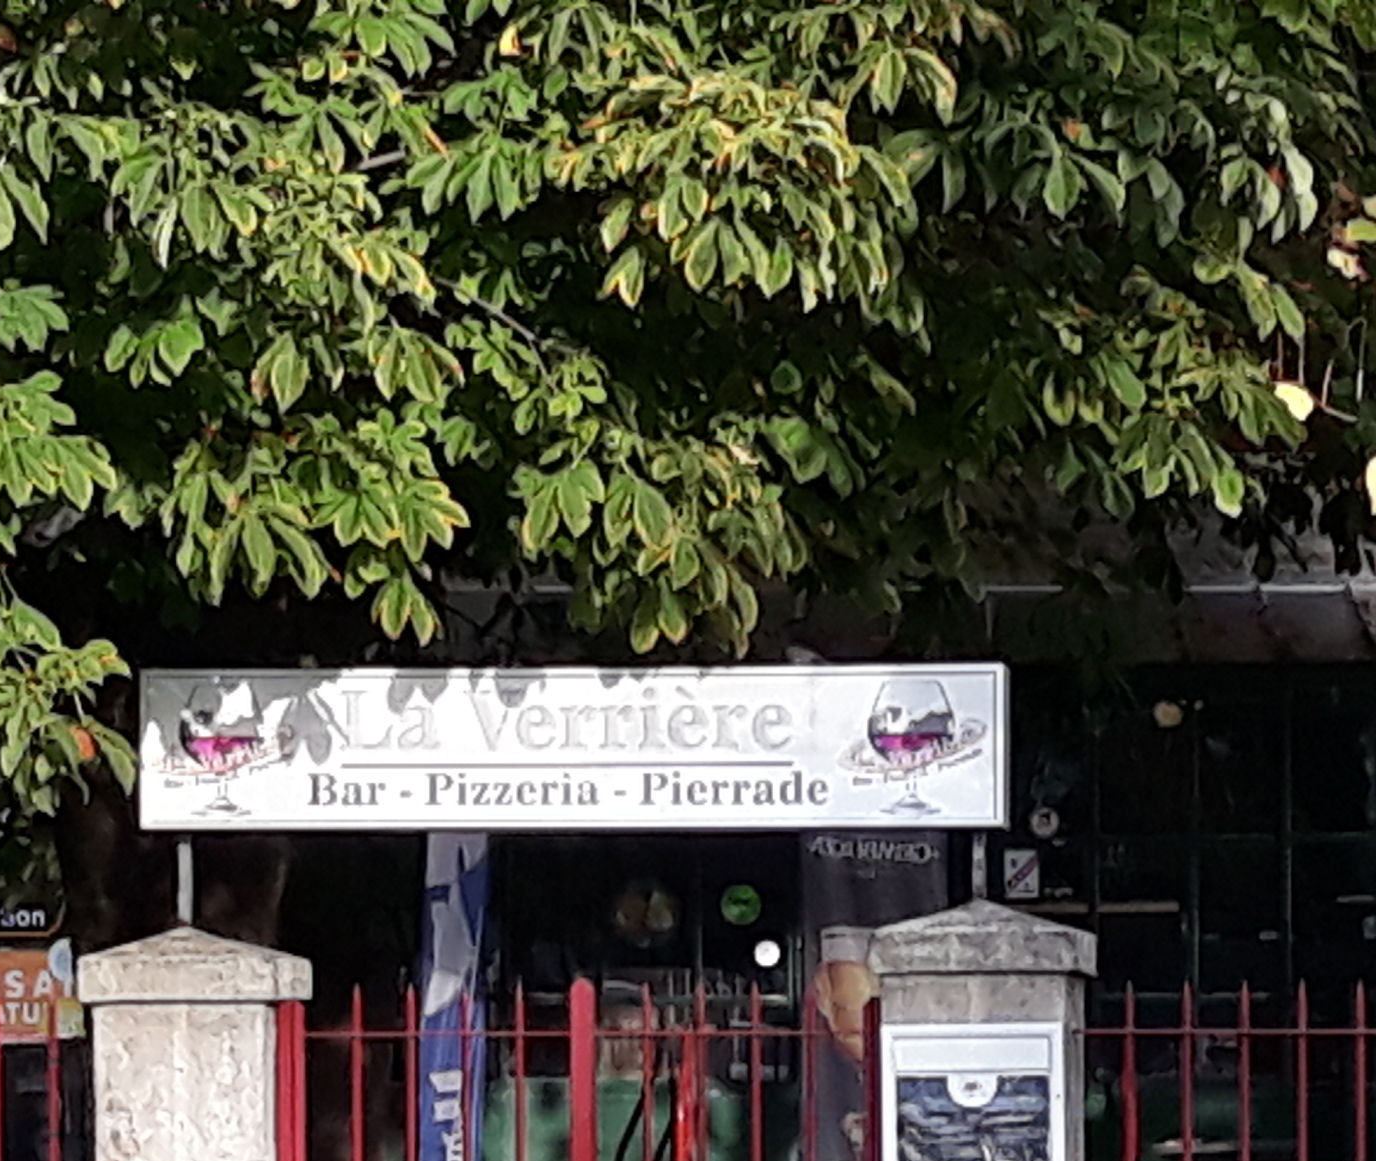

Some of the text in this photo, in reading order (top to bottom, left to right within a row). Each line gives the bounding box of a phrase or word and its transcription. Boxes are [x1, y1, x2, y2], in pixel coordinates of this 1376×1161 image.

[339, 689, 442, 751] La
[462, 685, 793, 752] Verrière
[306, 772, 387, 806] Bar
[424, 771, 600, 806] Pizzeria
[638, 770, 830, 806] Pierrade
